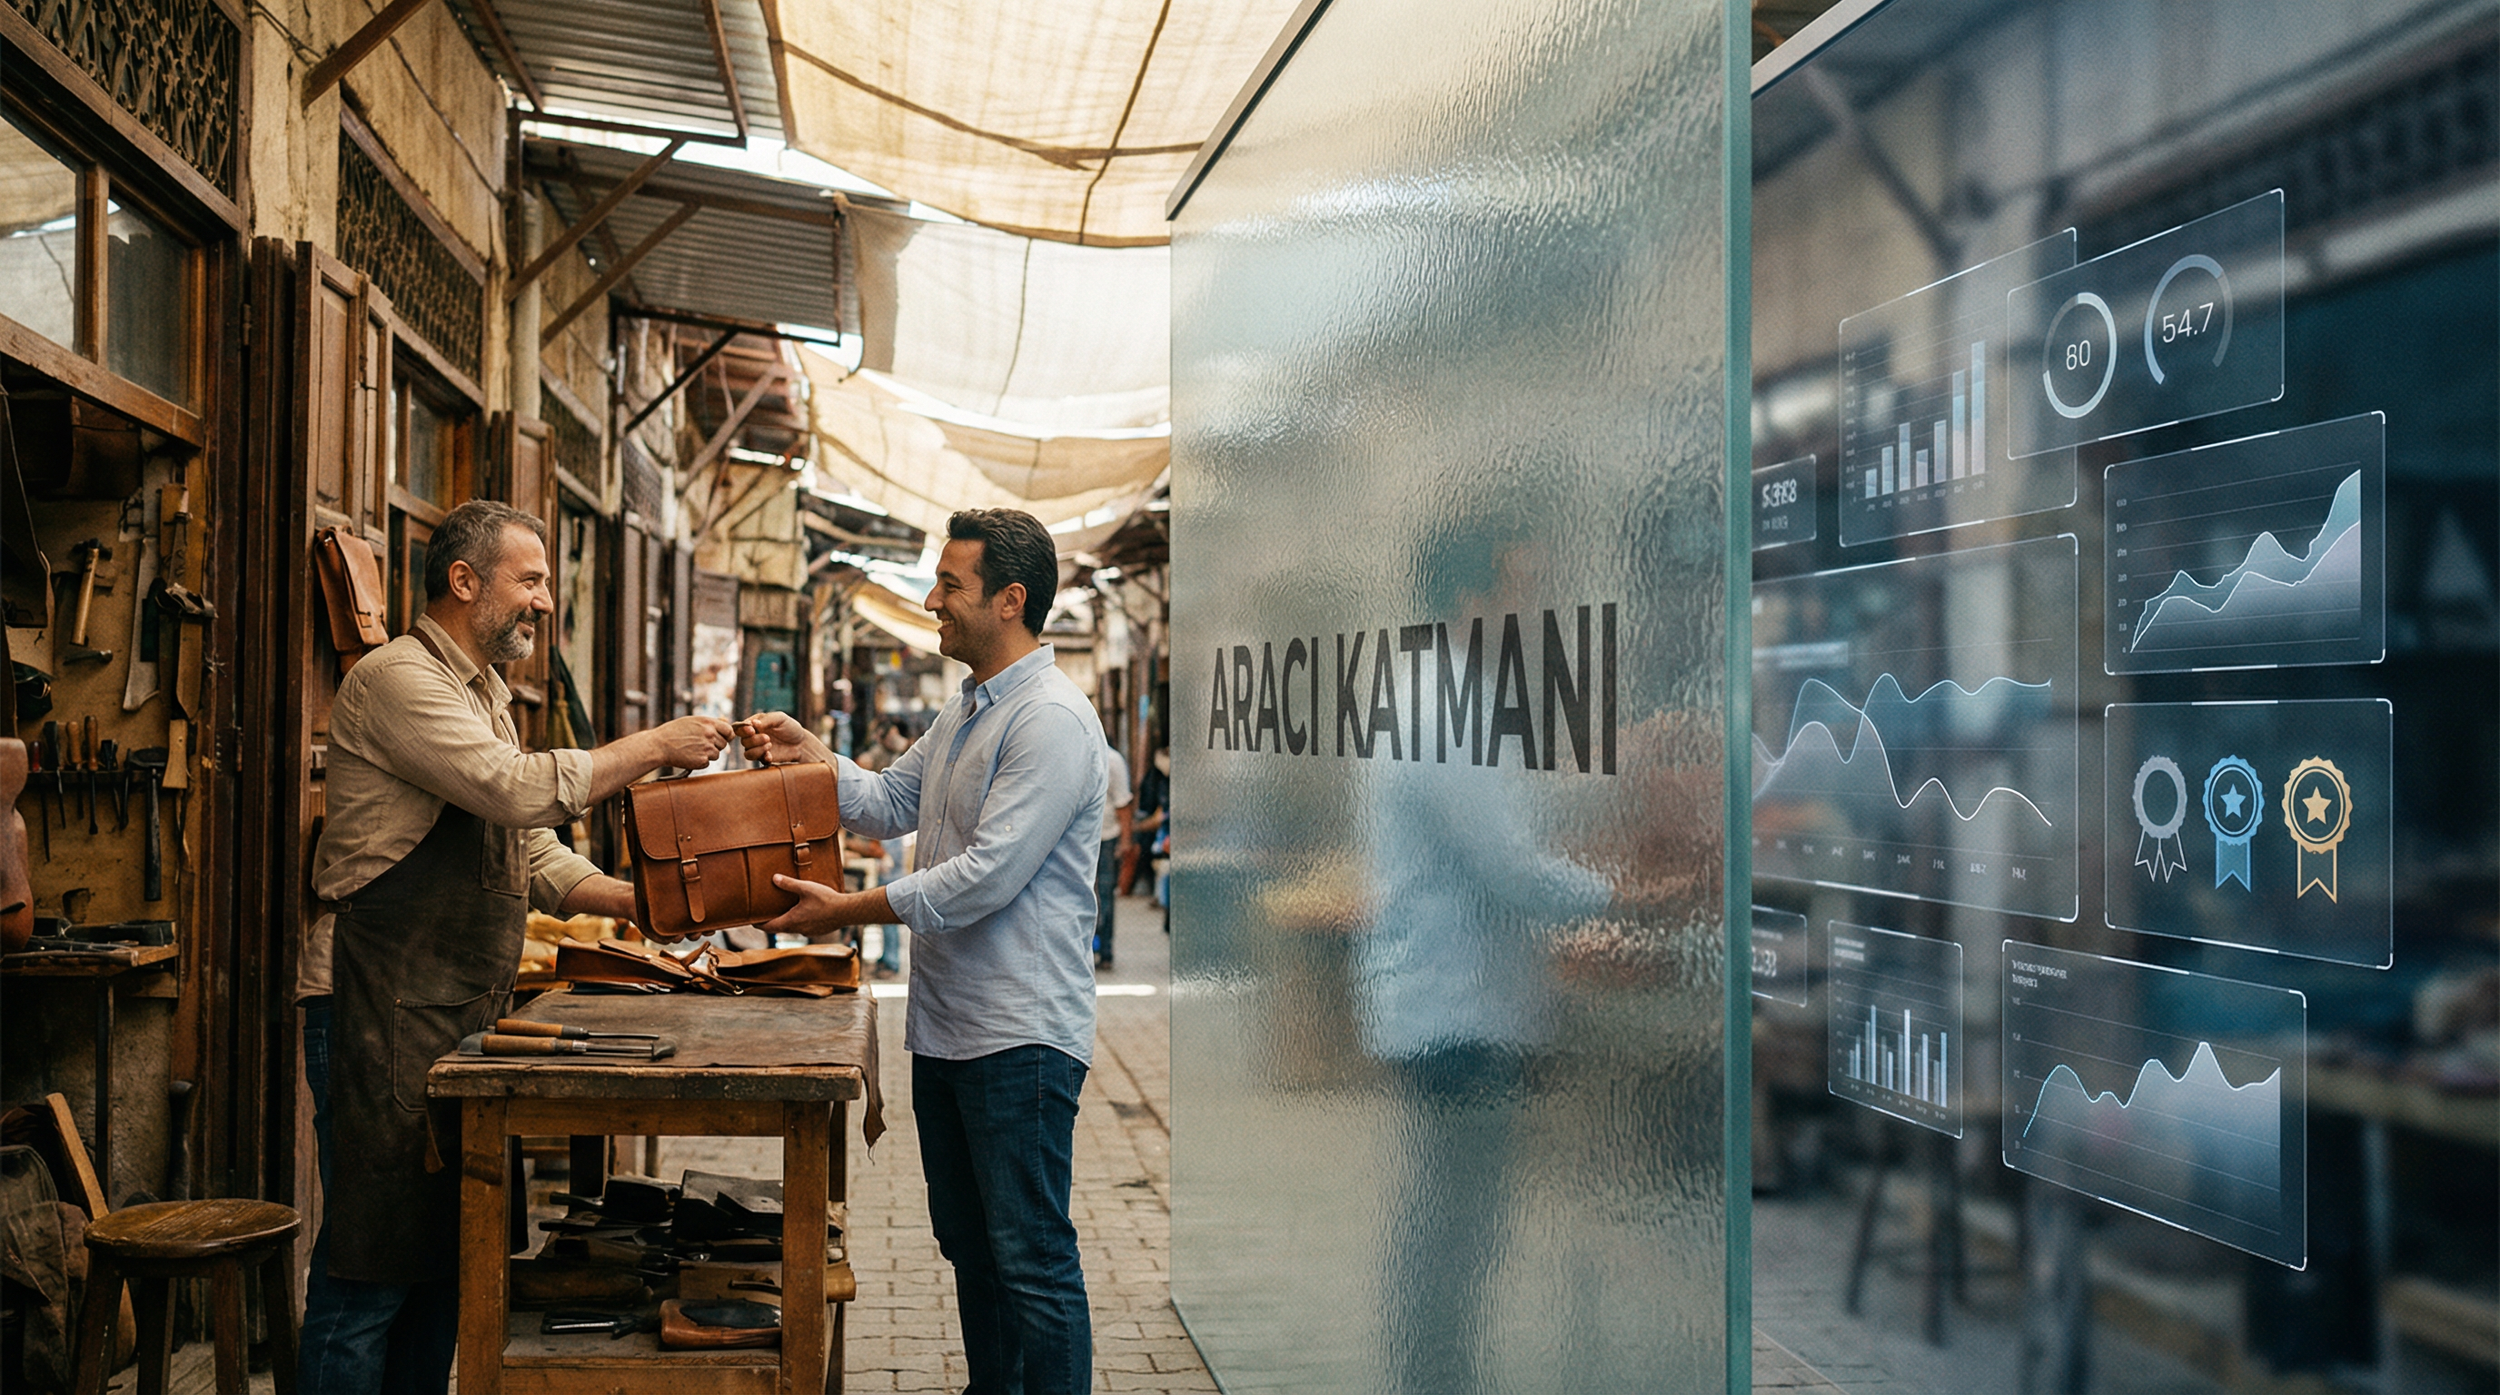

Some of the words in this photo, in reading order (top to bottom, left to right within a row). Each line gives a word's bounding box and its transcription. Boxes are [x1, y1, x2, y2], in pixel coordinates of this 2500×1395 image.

[2162, 301, 2214, 343] 54.7
[2065, 340, 2091, 371] 80
[1208, 636, 1319, 756] ARACI
[1336, 603, 1617, 775] KATMANI
